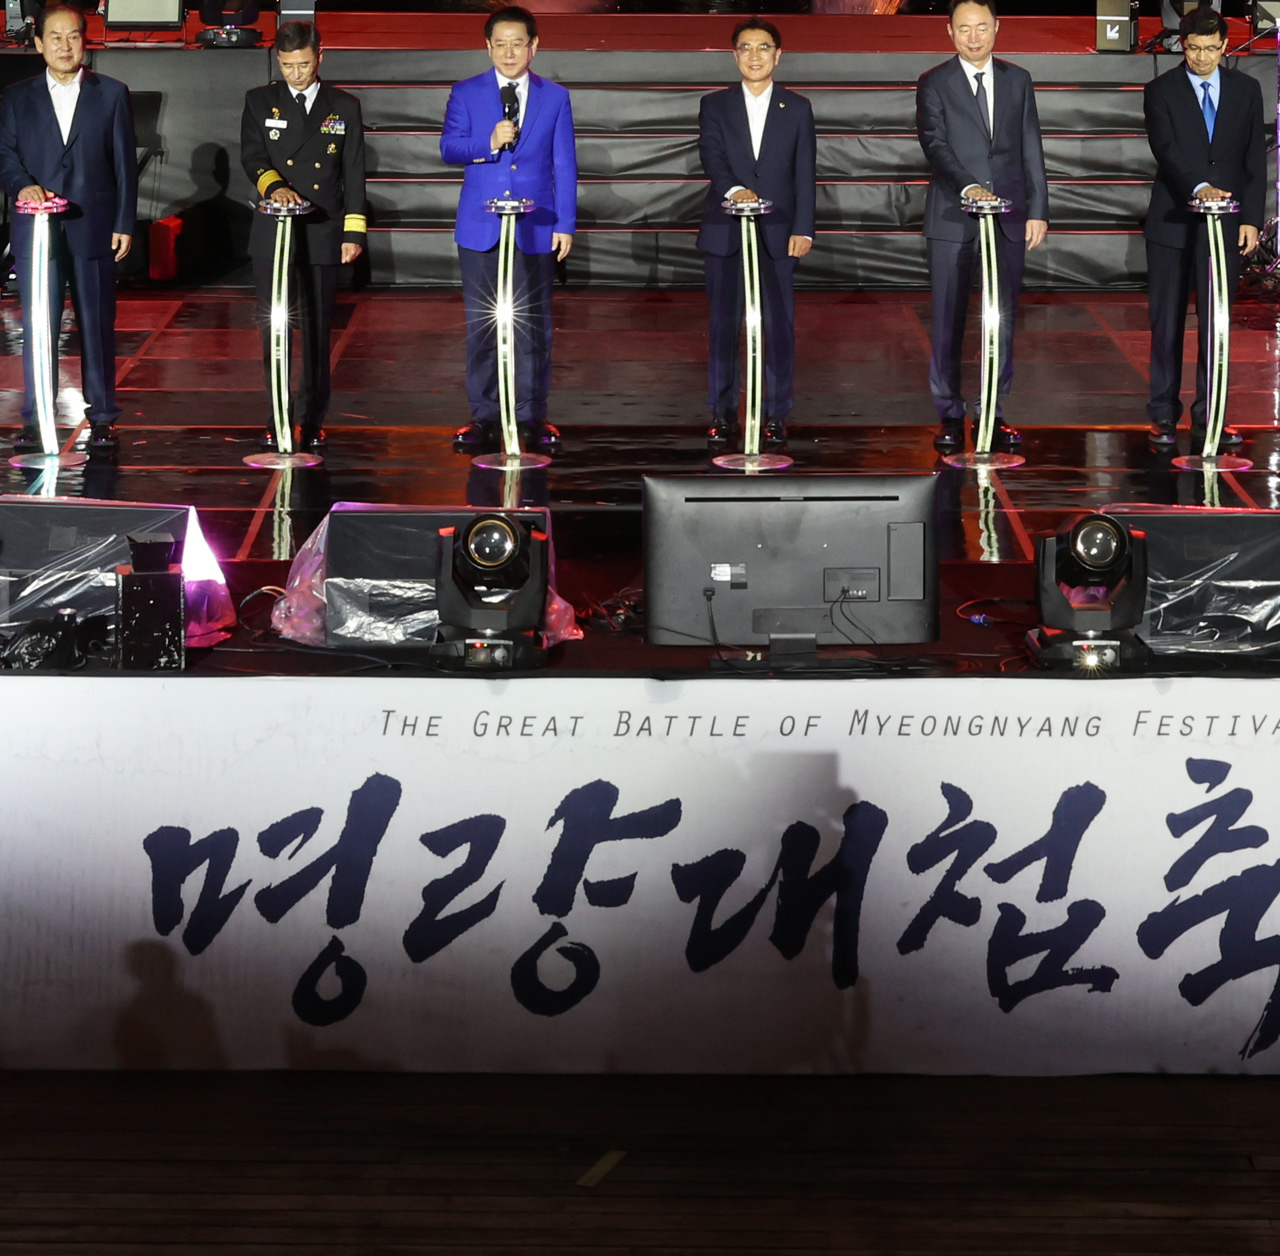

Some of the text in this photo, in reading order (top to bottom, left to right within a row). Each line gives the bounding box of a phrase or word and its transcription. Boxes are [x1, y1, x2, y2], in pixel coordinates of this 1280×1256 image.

[381, 709, 443, 737] THE
[472, 710, 585, 737] GREAT
[612, 710, 750, 737] BATTLE
[848, 709, 1102, 738] MYEONGNYANG
